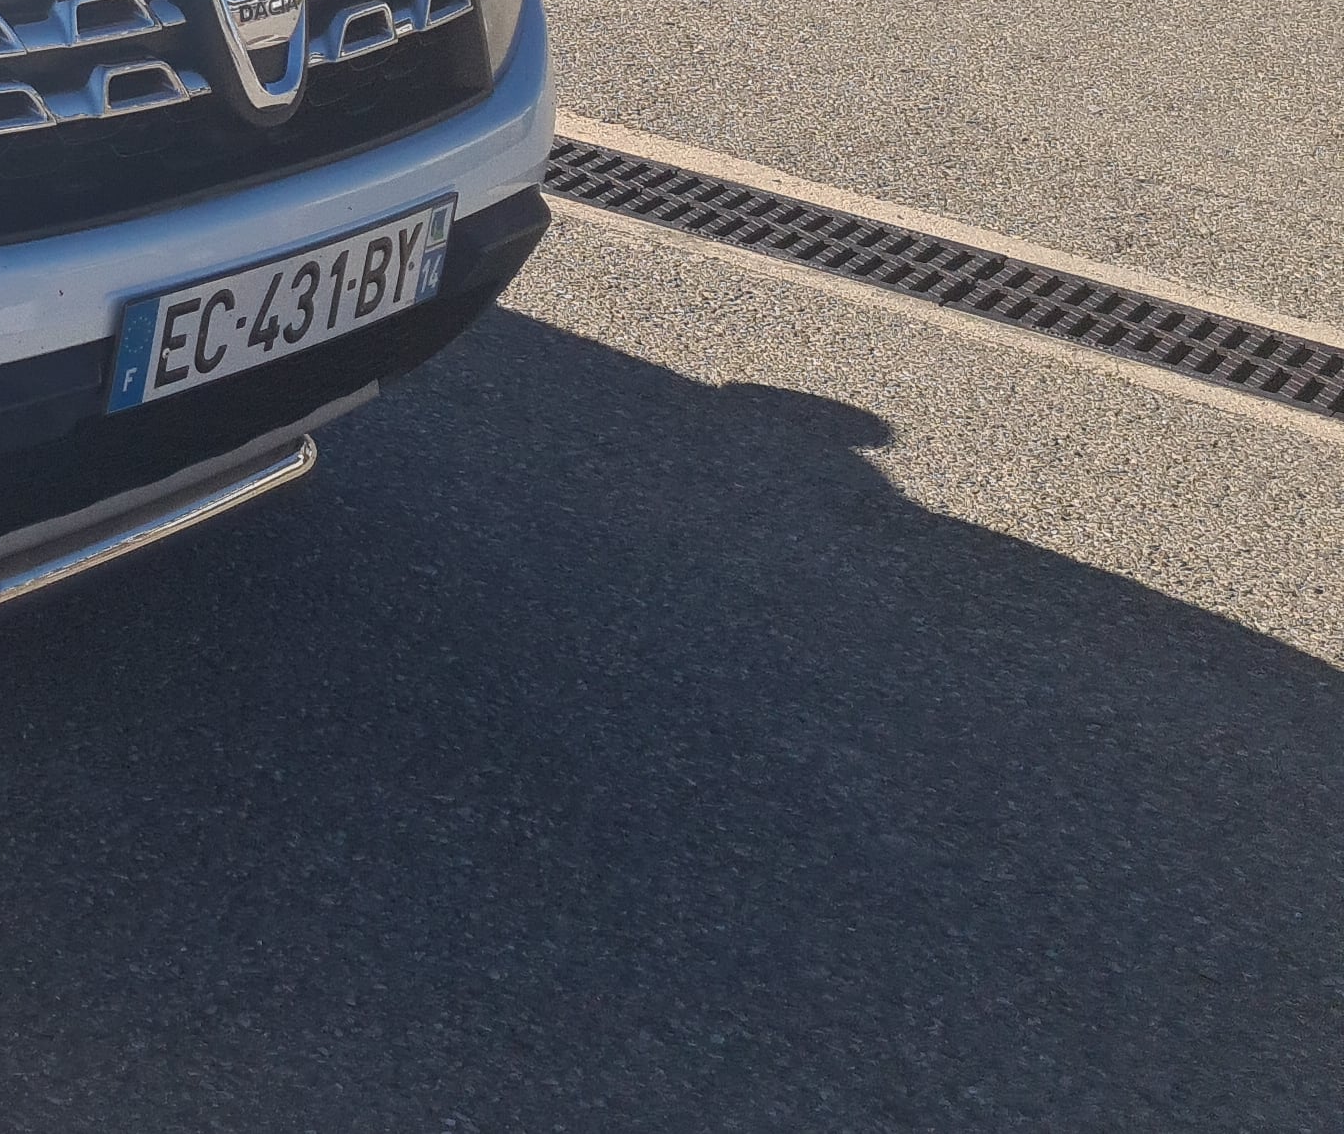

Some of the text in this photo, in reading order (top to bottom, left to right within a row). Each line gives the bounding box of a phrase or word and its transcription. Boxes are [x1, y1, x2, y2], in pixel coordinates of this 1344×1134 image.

[122, 222, 441, 393] F EC-431-BY 14
